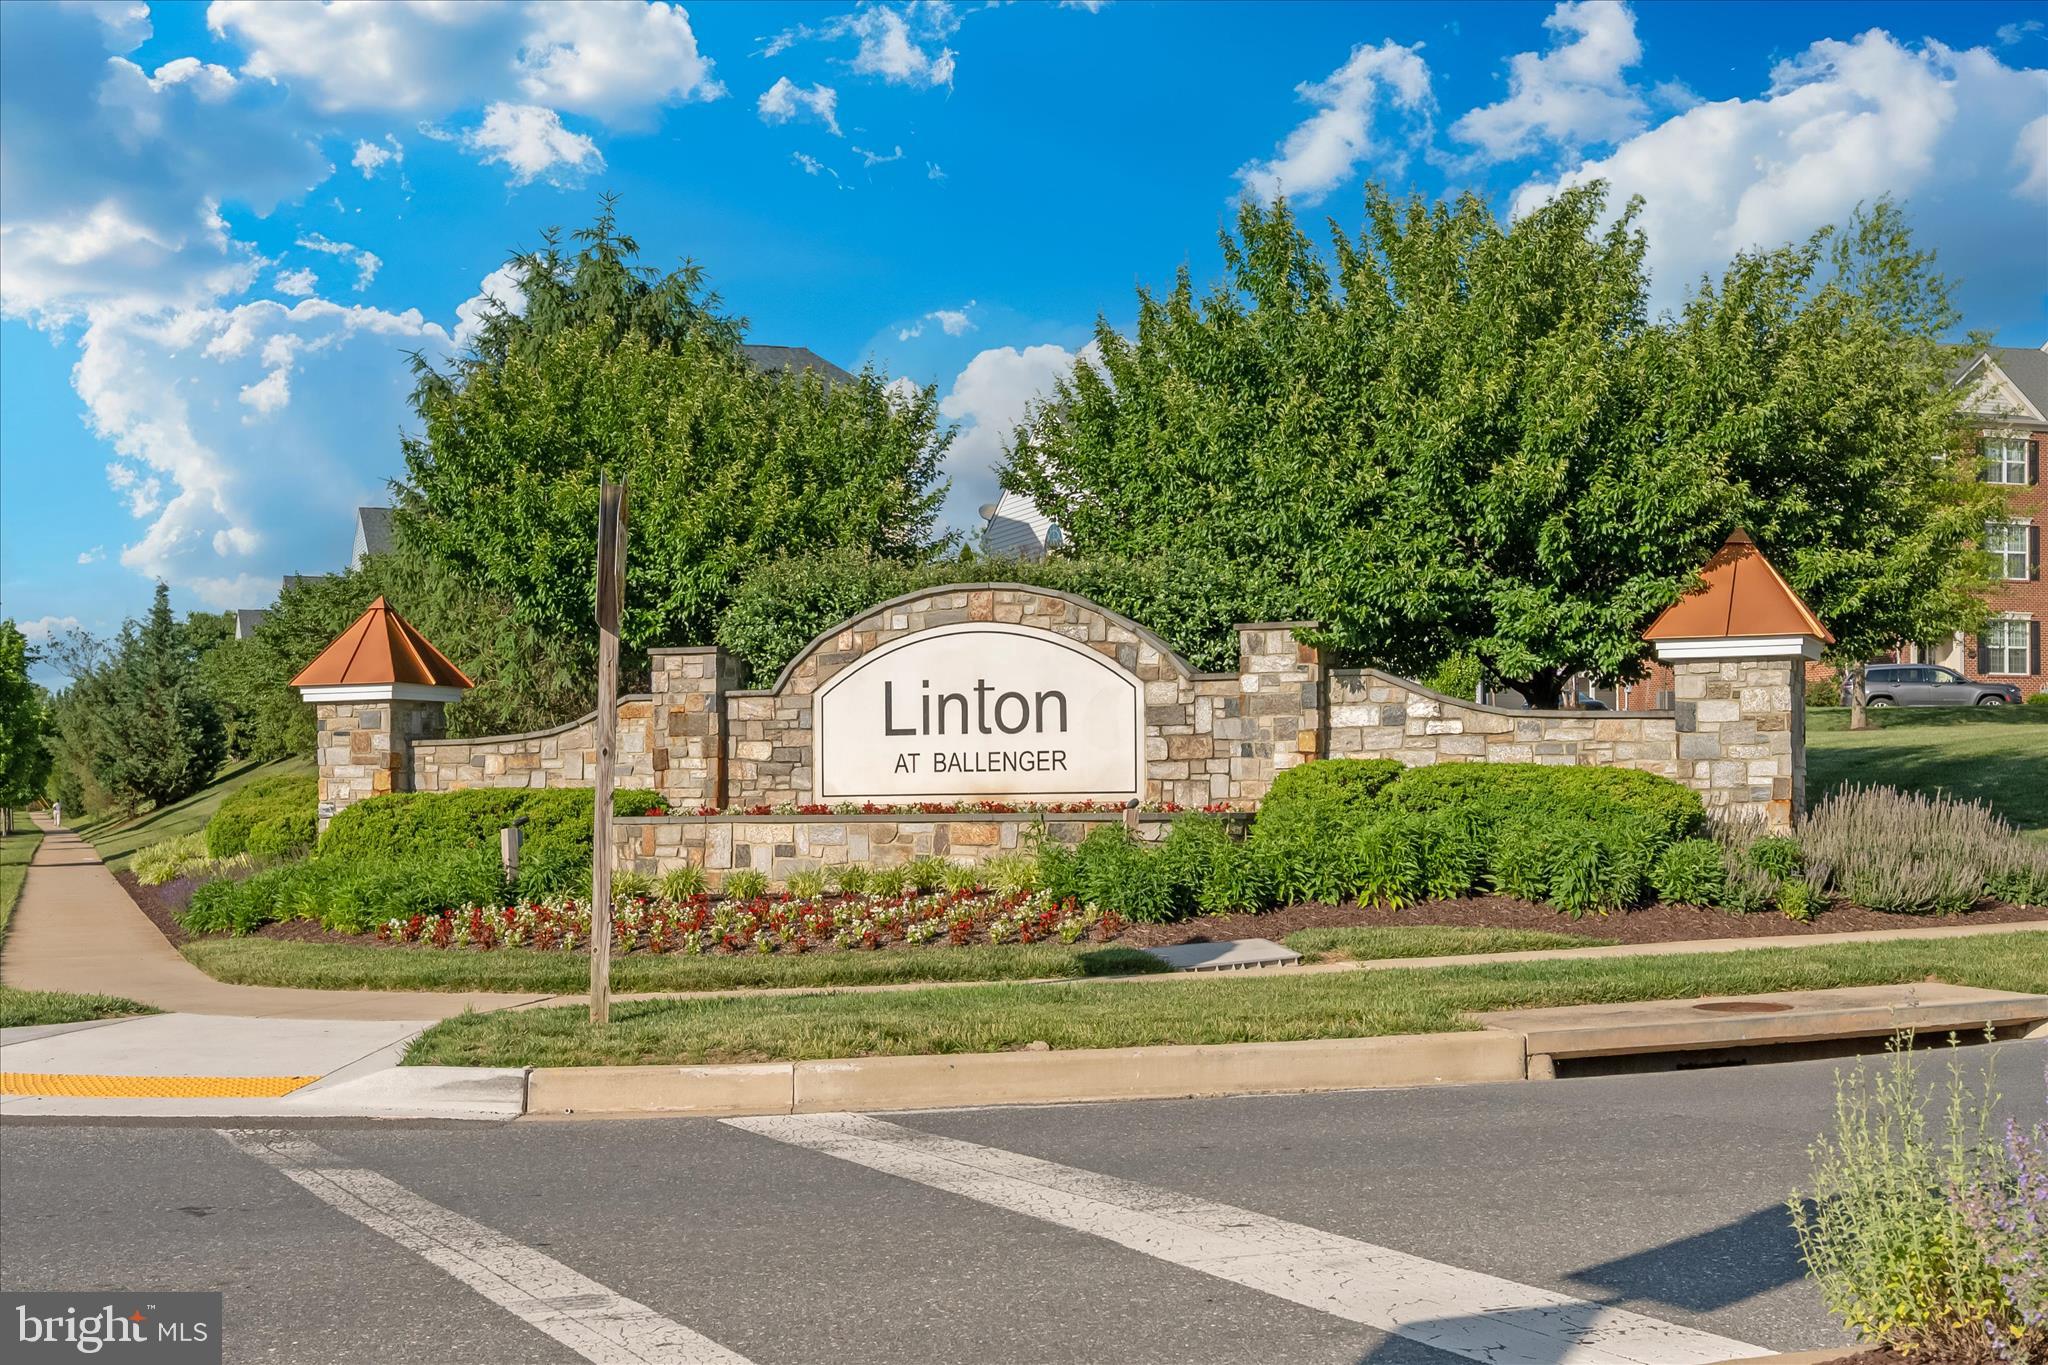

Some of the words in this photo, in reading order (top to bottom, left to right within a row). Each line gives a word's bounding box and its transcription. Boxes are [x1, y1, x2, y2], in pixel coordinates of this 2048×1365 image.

[884, 679, 1068, 737] Linton
[894, 752, 921, 774] AT
[933, 750, 1068, 773] BALLENGER
